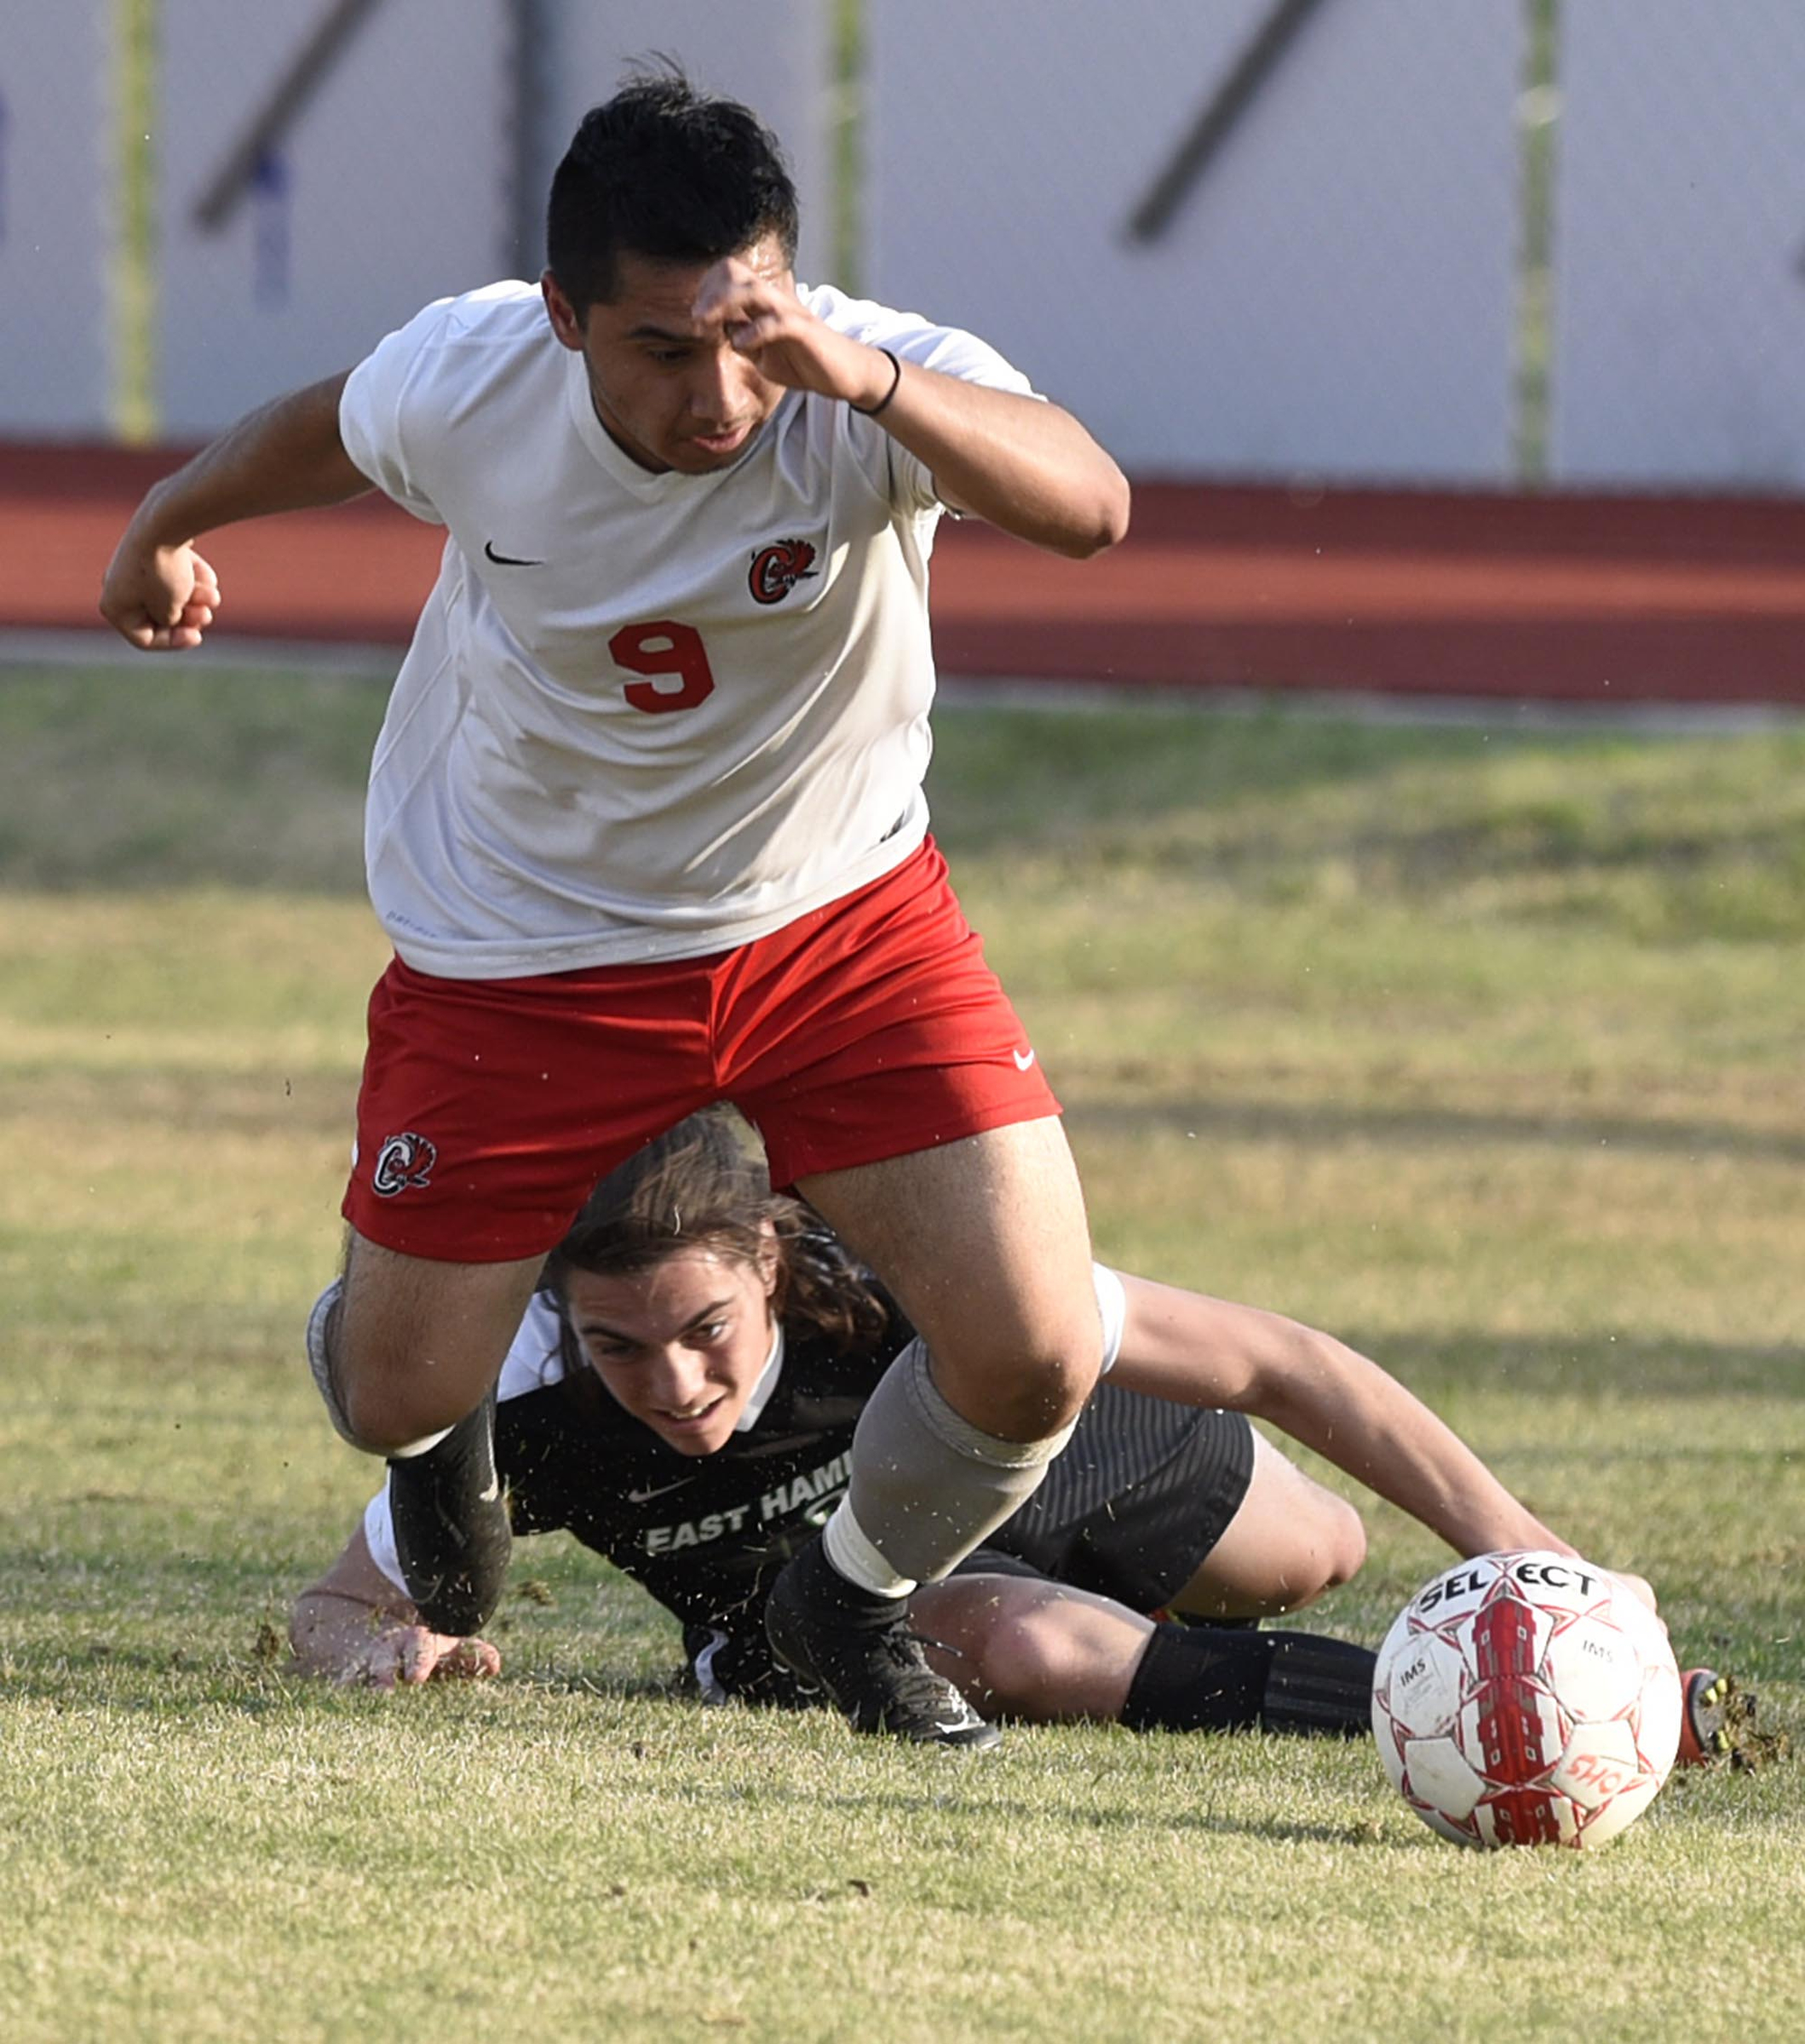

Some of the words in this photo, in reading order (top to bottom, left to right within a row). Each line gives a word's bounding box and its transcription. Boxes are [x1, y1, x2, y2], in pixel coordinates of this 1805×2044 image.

[608, 620, 716, 715] 9
[647, 1504, 750, 1551] EAST
[1420, 1562, 1596, 1613] SELECT
[1400, 1657, 1426, 1687] IMS
